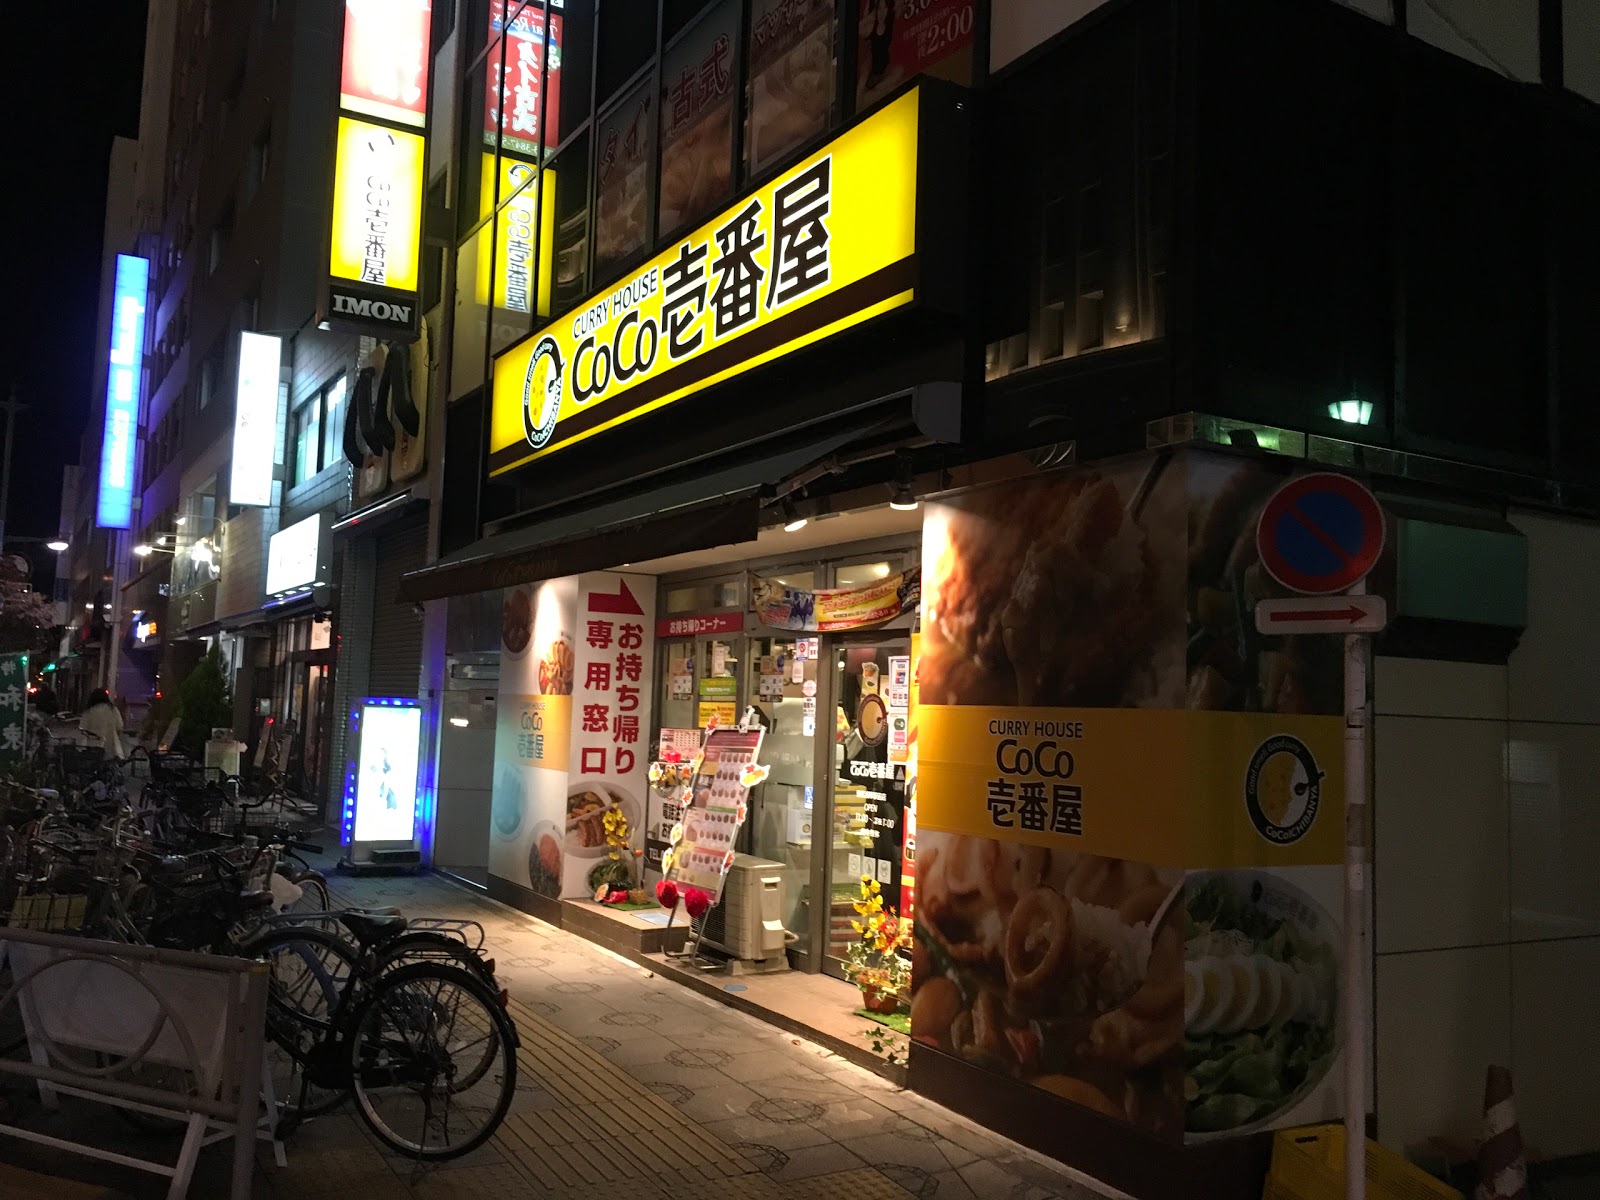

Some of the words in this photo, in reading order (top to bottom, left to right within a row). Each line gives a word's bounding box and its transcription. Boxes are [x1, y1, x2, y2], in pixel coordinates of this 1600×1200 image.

[332, 294, 411, 324] IMON
[572, 297, 611, 339] CURRY
[612, 266, 659, 318] HOUSE
[669, 617, 727, 634] お持ち帰りコーナー
[580, 619, 614, 775] 専用窓口
[612, 622, 645, 775] お持ち帰り
[520, 711, 543, 731] CoCo
[989, 720, 1031, 736] CURRY
[1034, 721, 1083, 739] HOUSE
[517, 733, 545, 759] 壱番屋
[996, 738, 1075, 779] CoCo
[863, 803, 878, 813] OPEN
[987, 777, 1082, 836] 壱番屋
[1265, 784, 1319, 840] CoCoICHIBANYA
